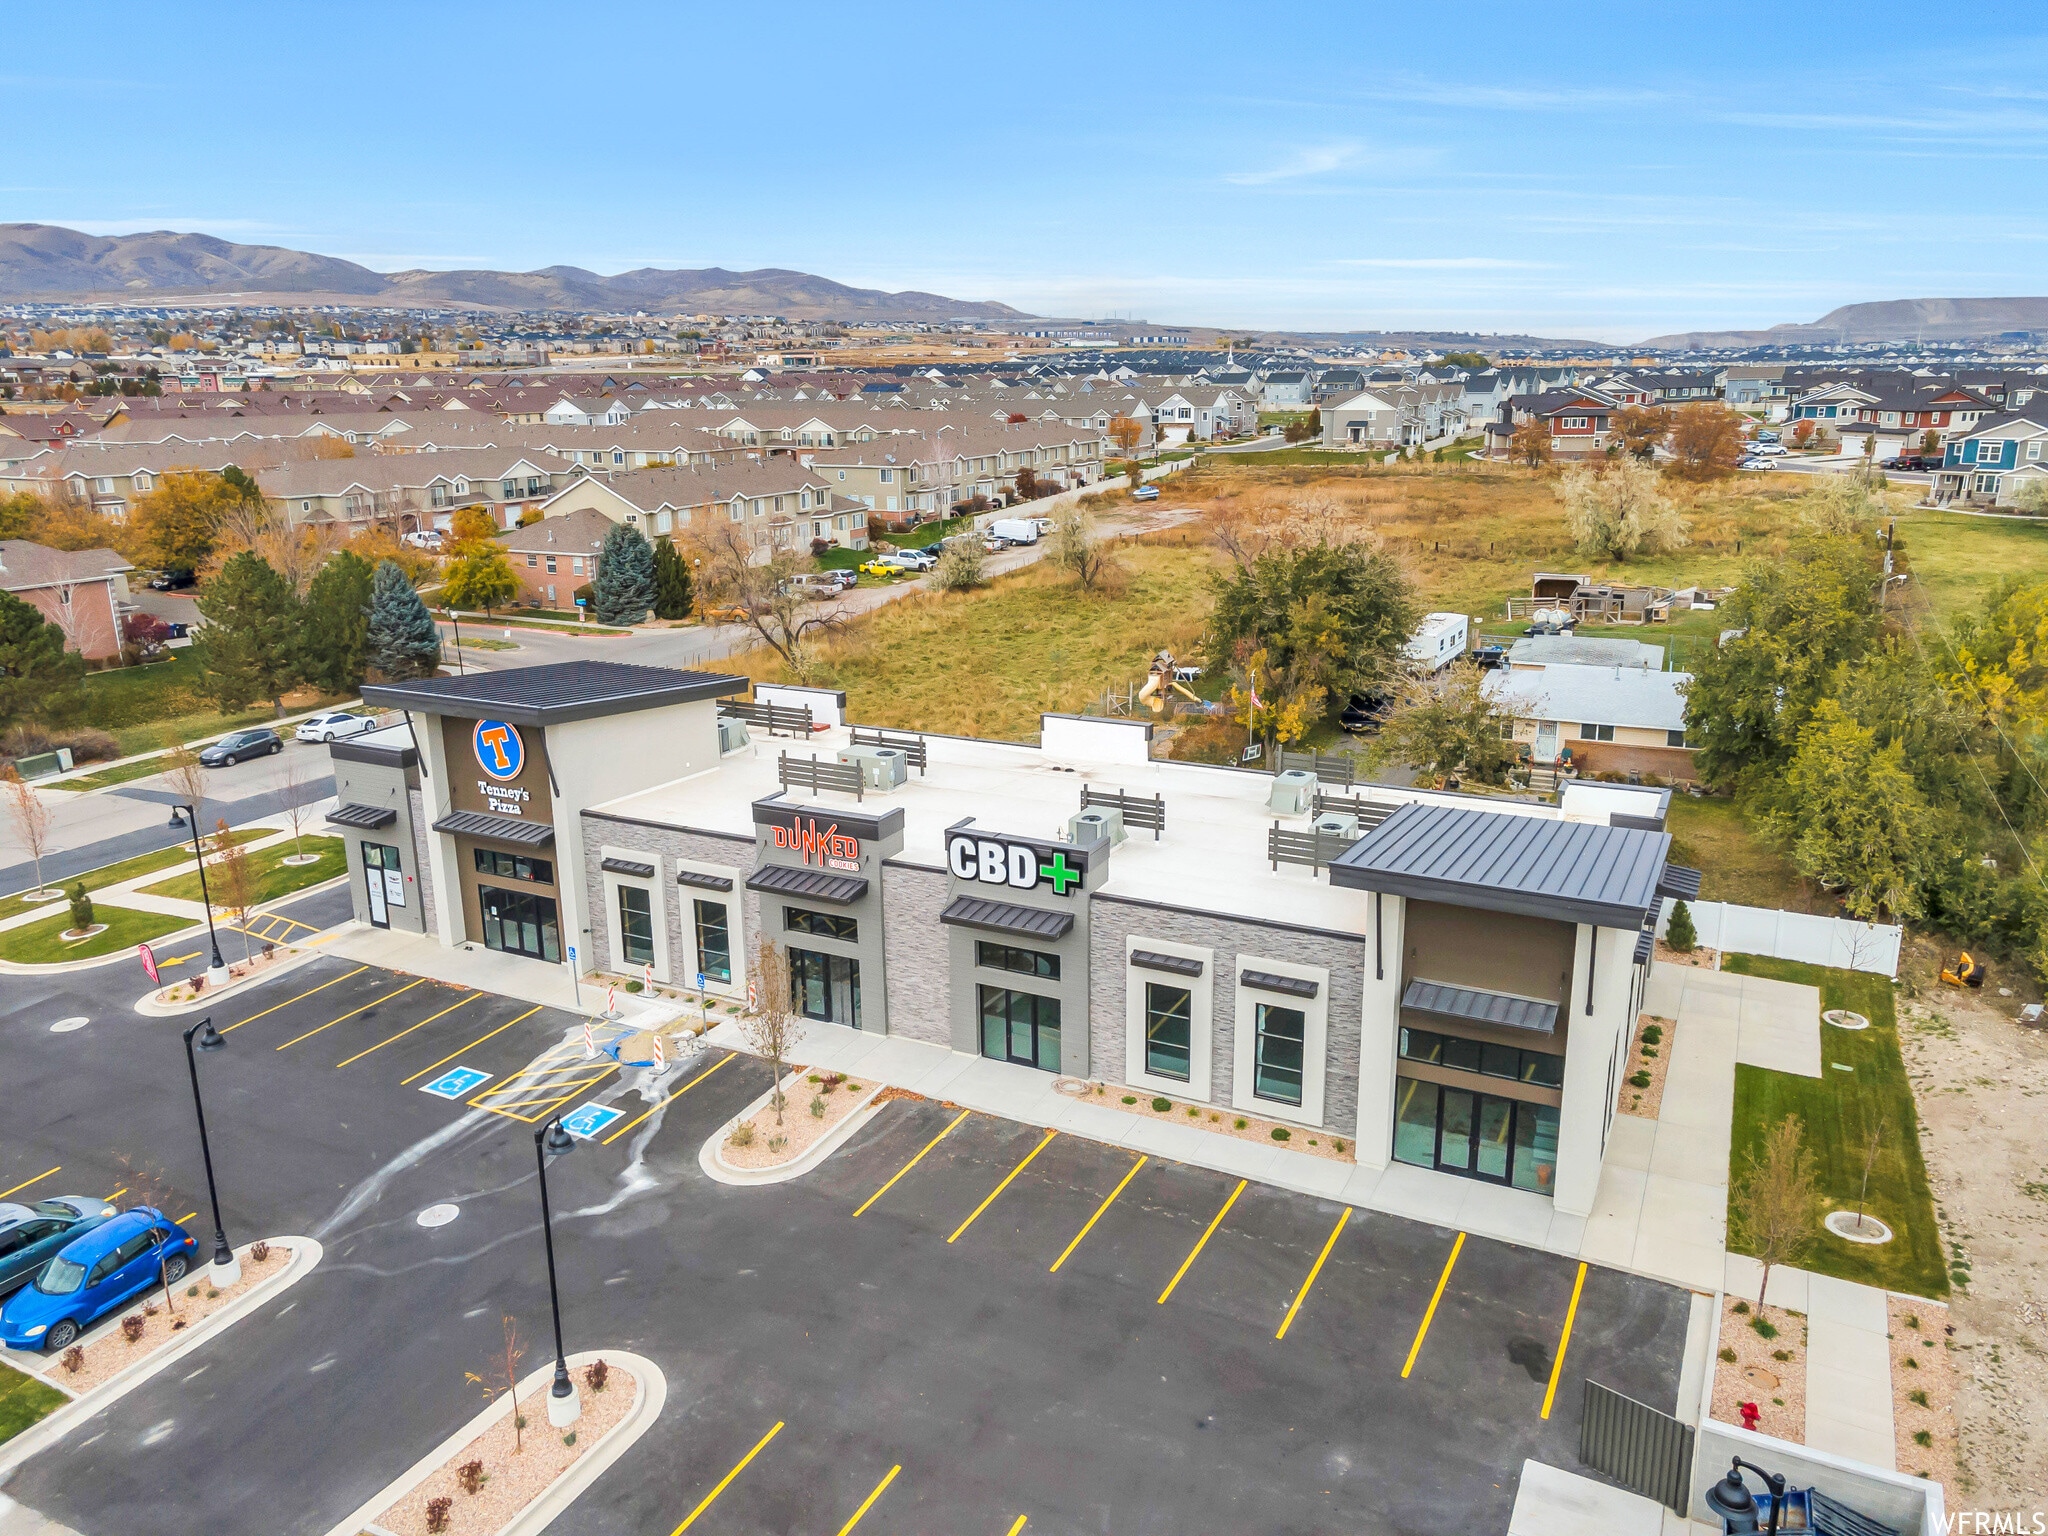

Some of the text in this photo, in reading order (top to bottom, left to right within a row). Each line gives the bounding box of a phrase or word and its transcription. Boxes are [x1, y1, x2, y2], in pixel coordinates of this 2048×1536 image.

[480, 726, 511, 770] T
[477, 780, 530, 801] Tenney's
[488, 798, 522, 815] Pizza
[770, 816, 858, 867] DUNKED
[829, 859, 860, 872] COOKIES
